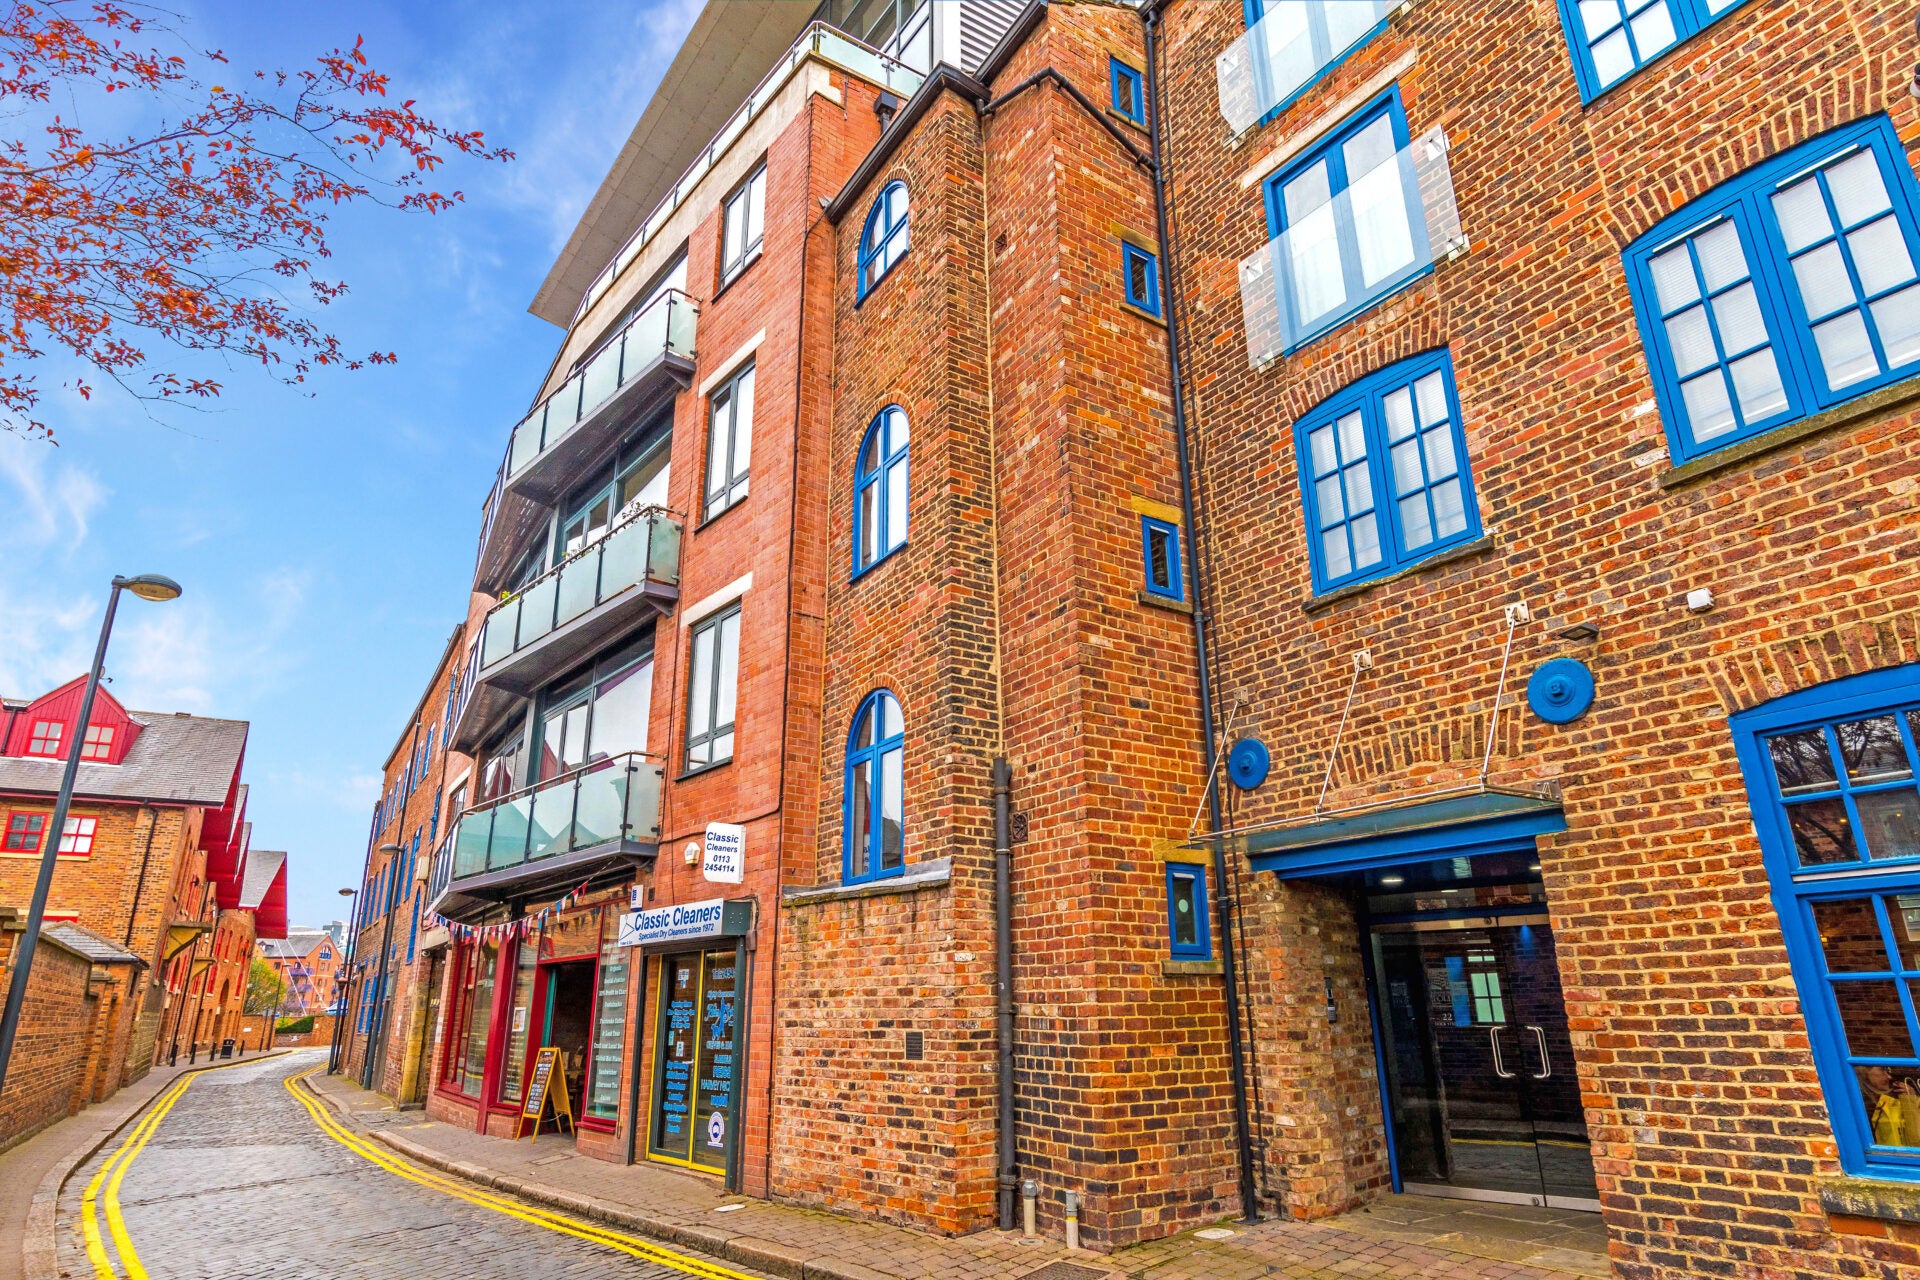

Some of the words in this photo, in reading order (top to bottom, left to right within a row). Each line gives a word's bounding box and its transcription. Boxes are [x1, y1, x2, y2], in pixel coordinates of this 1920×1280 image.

[706, 831, 739, 843] Classic
[706, 843, 738, 853] Cleaners
[713, 854, 731, 863] 0113
[704, 863, 735, 873] 2454114
[634, 909, 670, 931] Classic
[673, 905, 721, 926] Cleaners
[638, 930, 659, 941] Specialist
[659, 929, 668, 939] Dry
[668, 927, 688, 937] Cleaners
[688, 925, 701, 933] since
[702, 923, 714, 932] 1972
